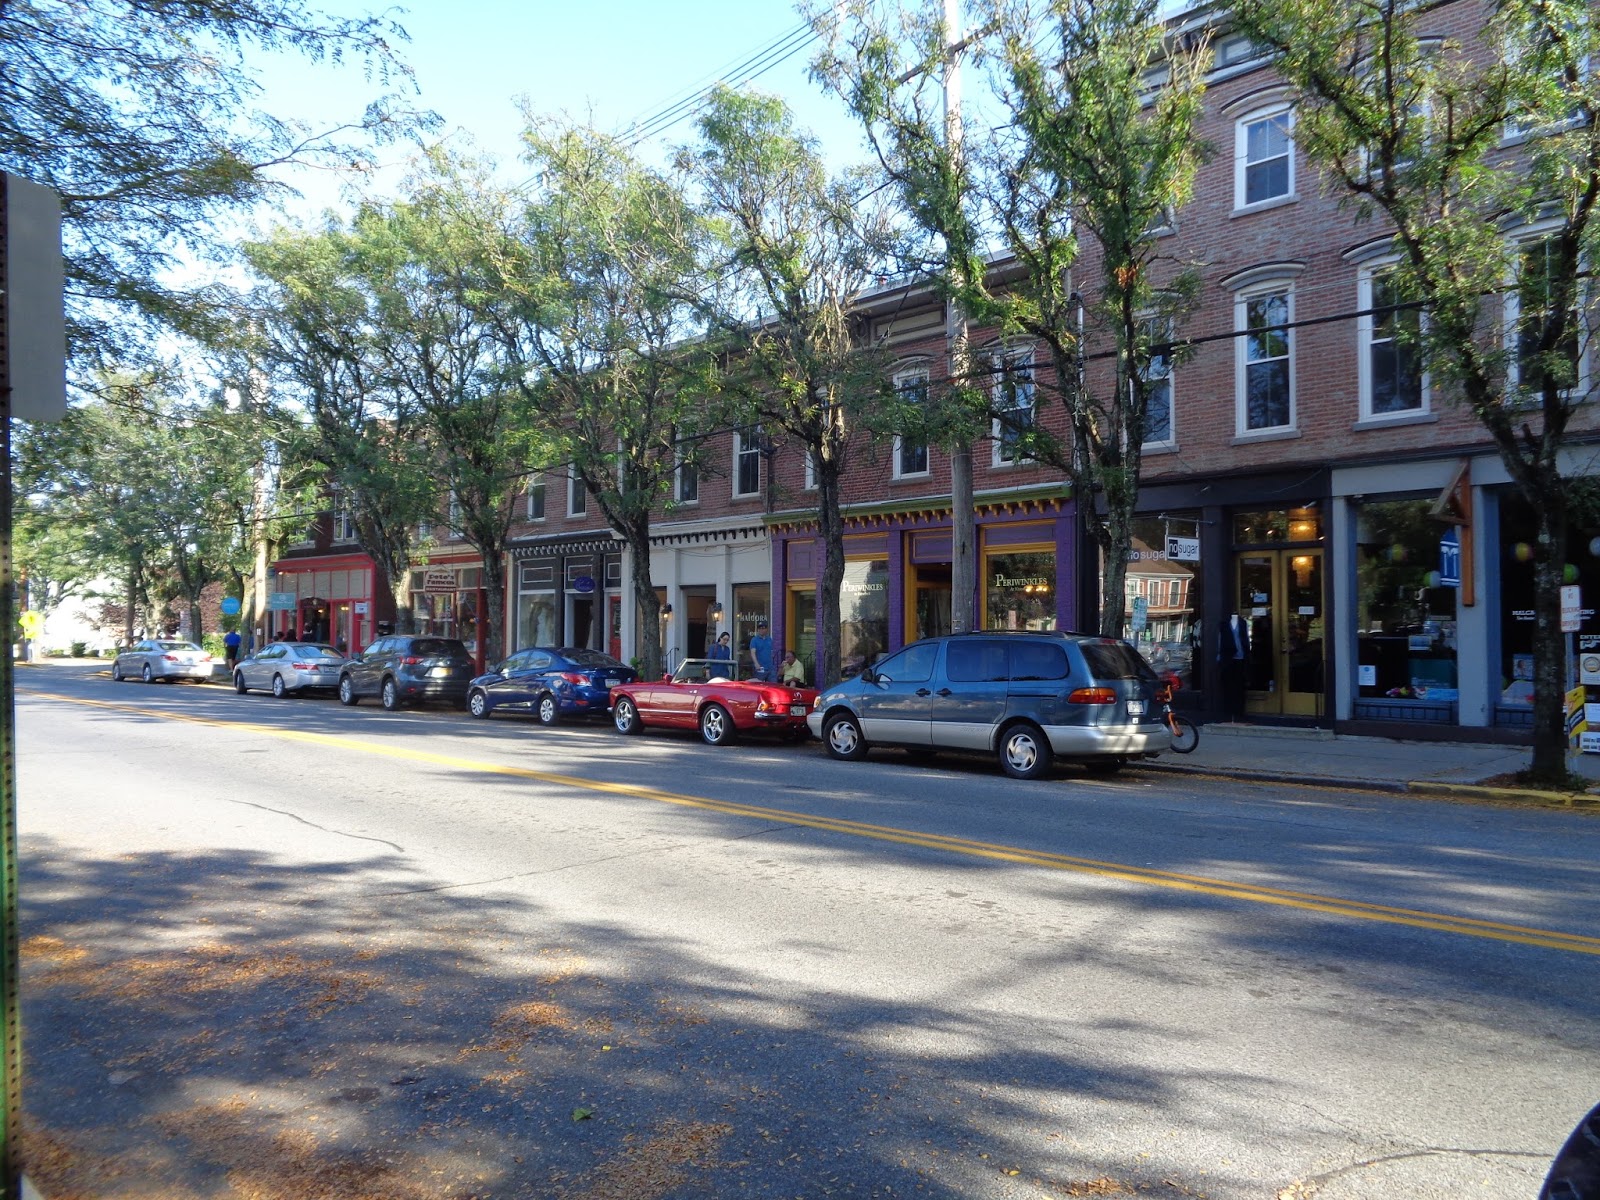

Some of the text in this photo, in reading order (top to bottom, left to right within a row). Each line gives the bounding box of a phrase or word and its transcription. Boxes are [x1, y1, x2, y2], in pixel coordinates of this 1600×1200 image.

[1140, 550, 1165, 561] suga
[1169, 542, 1199, 557] no sugar
[842, 580, 884, 592] PERIWINKLES
[995, 573, 1048, 587] PERIWINKLES
